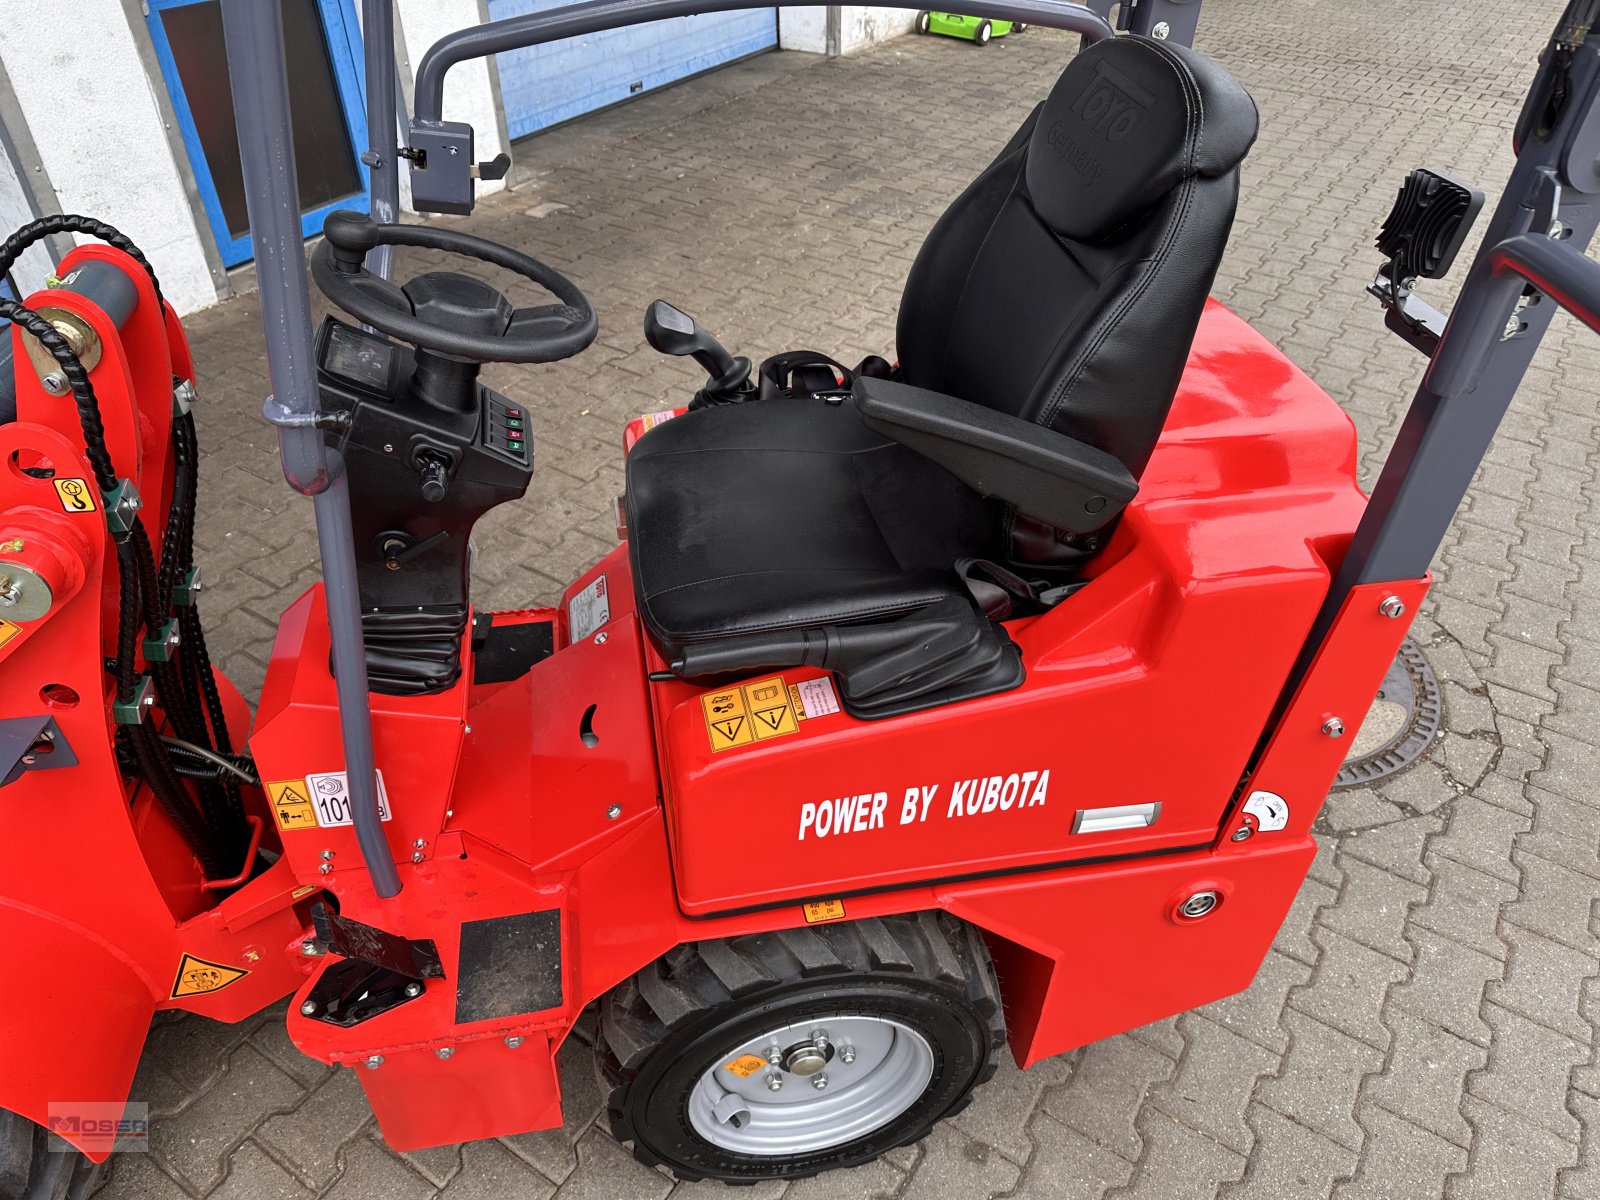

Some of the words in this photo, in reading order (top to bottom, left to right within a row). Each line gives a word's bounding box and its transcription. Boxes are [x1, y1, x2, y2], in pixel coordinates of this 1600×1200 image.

[1069, 58, 1157, 141] TOYO
[1048, 119, 1108, 187] Germany
[320, 796, 353, 823] 101
[798, 791, 888, 841] POWER
[899, 784, 939, 826] BY
[947, 769, 1050, 819] KUBOTA
